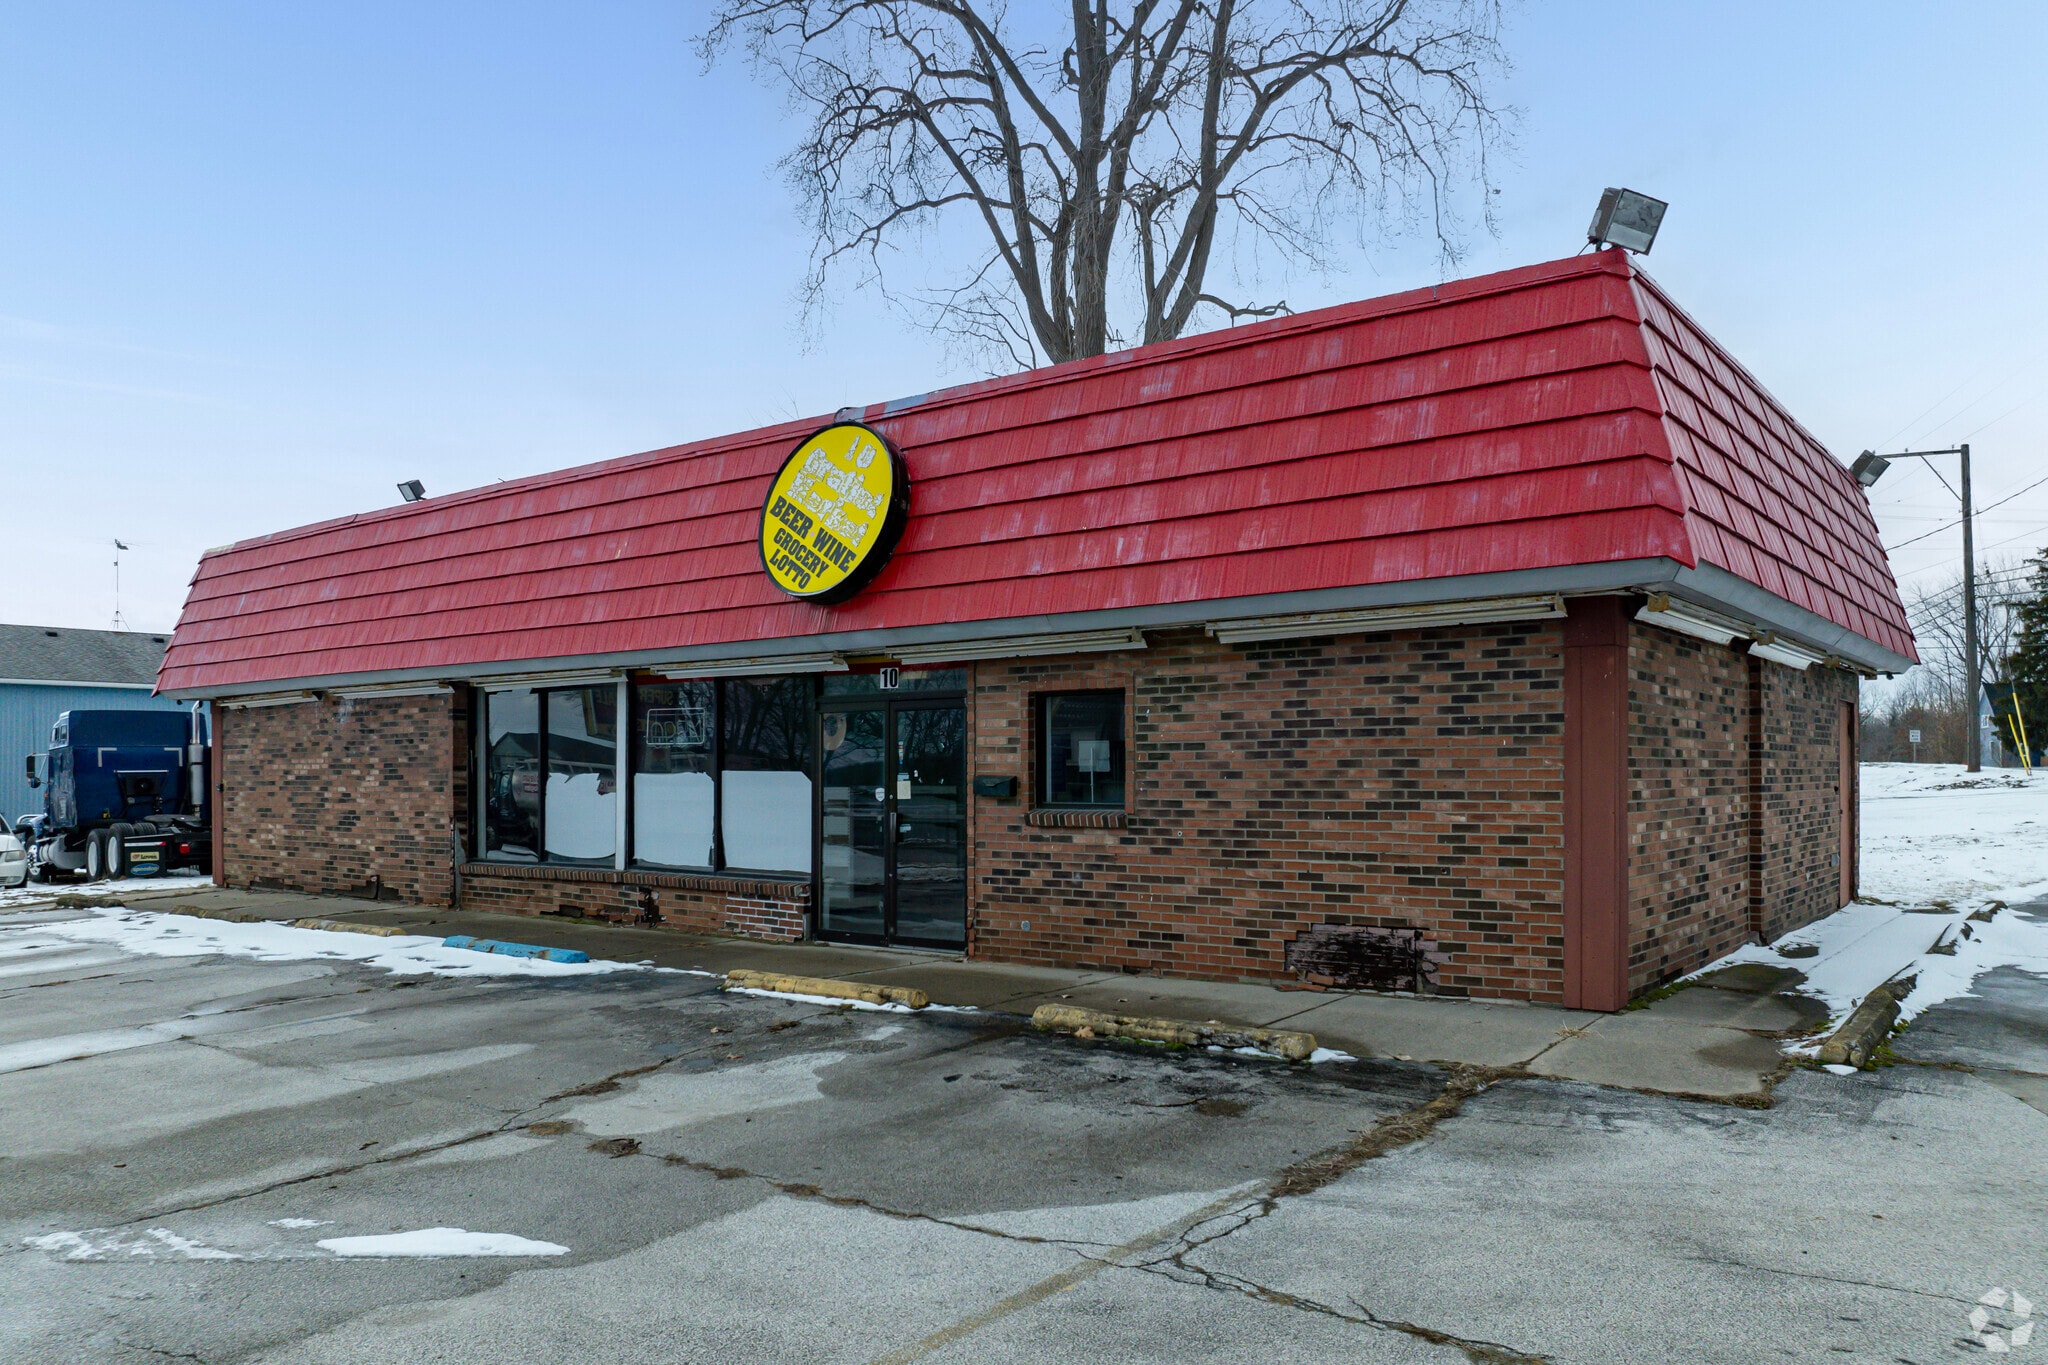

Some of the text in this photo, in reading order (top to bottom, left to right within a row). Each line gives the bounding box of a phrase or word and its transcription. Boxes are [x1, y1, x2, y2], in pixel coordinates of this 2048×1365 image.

[844, 435, 877, 469] 10
[769, 495, 857, 573] BEER WINE
[773, 528, 829, 578] GROCERY
[769, 548, 811, 589] LOTTO
[881, 668, 898, 688] 10
